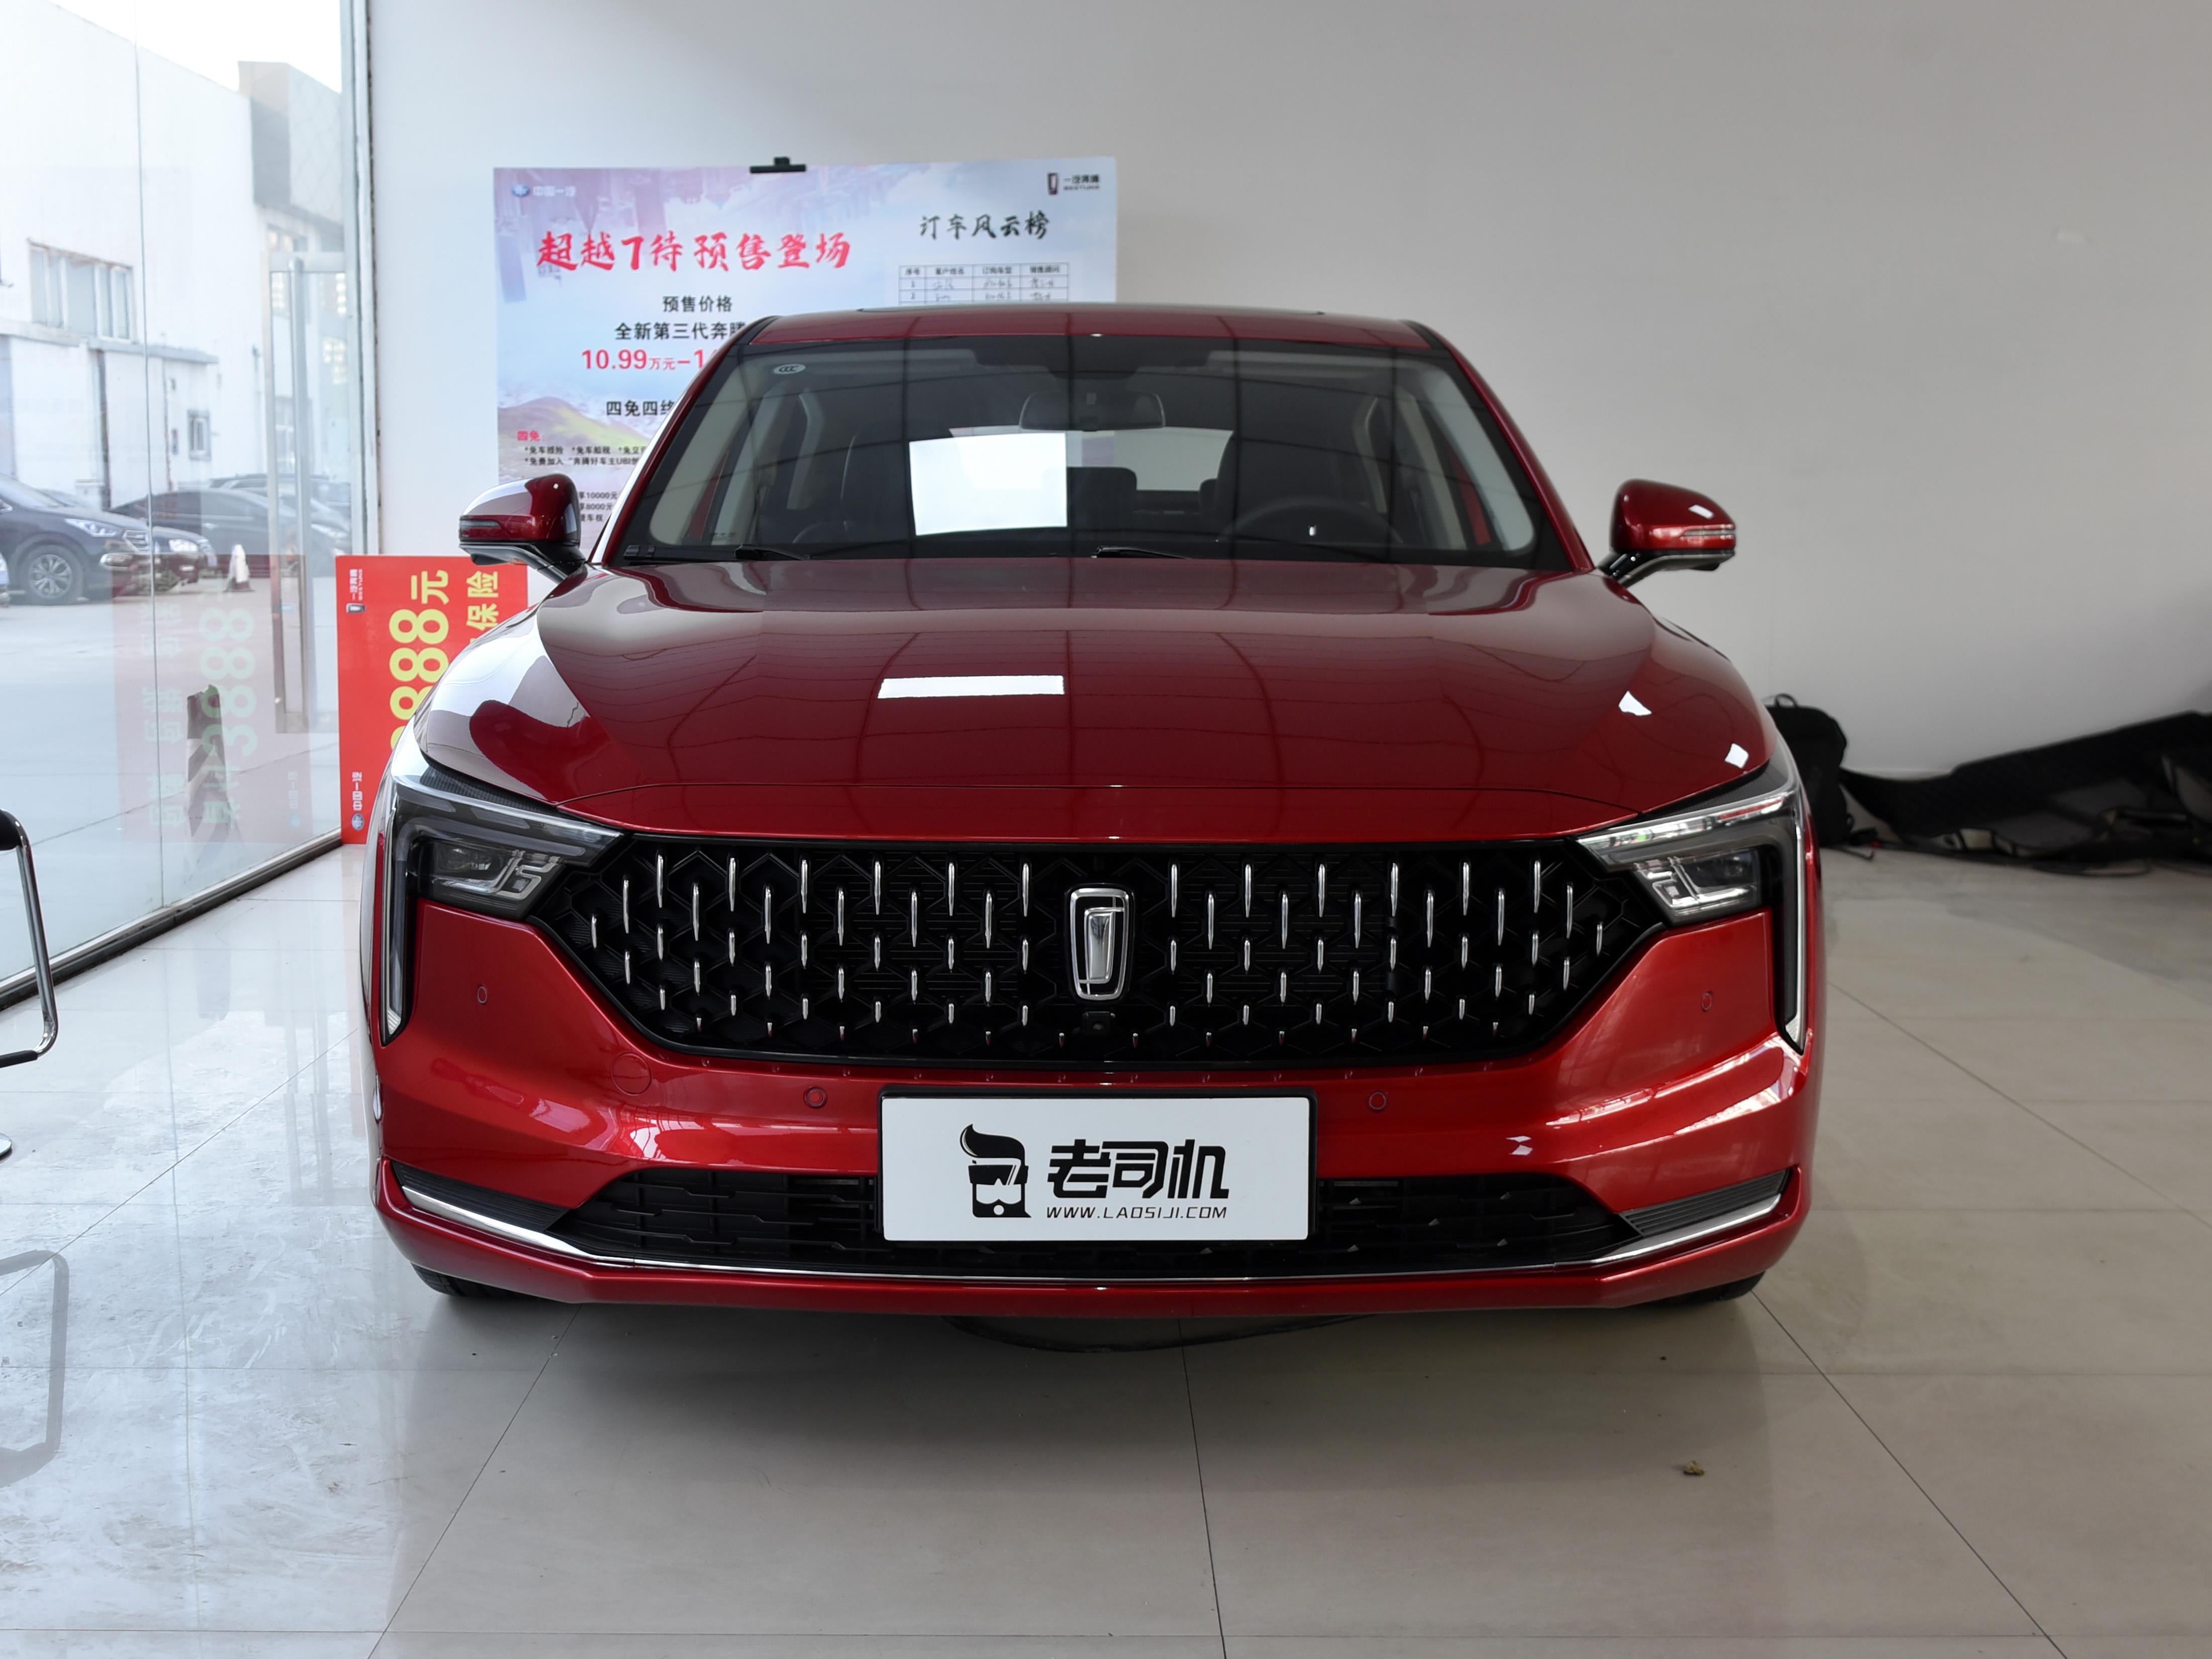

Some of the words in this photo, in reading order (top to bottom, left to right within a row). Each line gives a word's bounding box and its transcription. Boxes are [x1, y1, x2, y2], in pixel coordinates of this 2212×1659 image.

[920, 210, 1049, 240] 订车风云榜
[663, 295, 732, 312] 预售价格
[466, 571, 499, 643] 保险
[389, 569, 449, 750] 888元
[352, 771, 363, 811] 中国一汽
[1047, 1139, 1229, 1199] 老司机
[1046, 1207, 1227, 1219] WWW.LAOSIJI.COM
